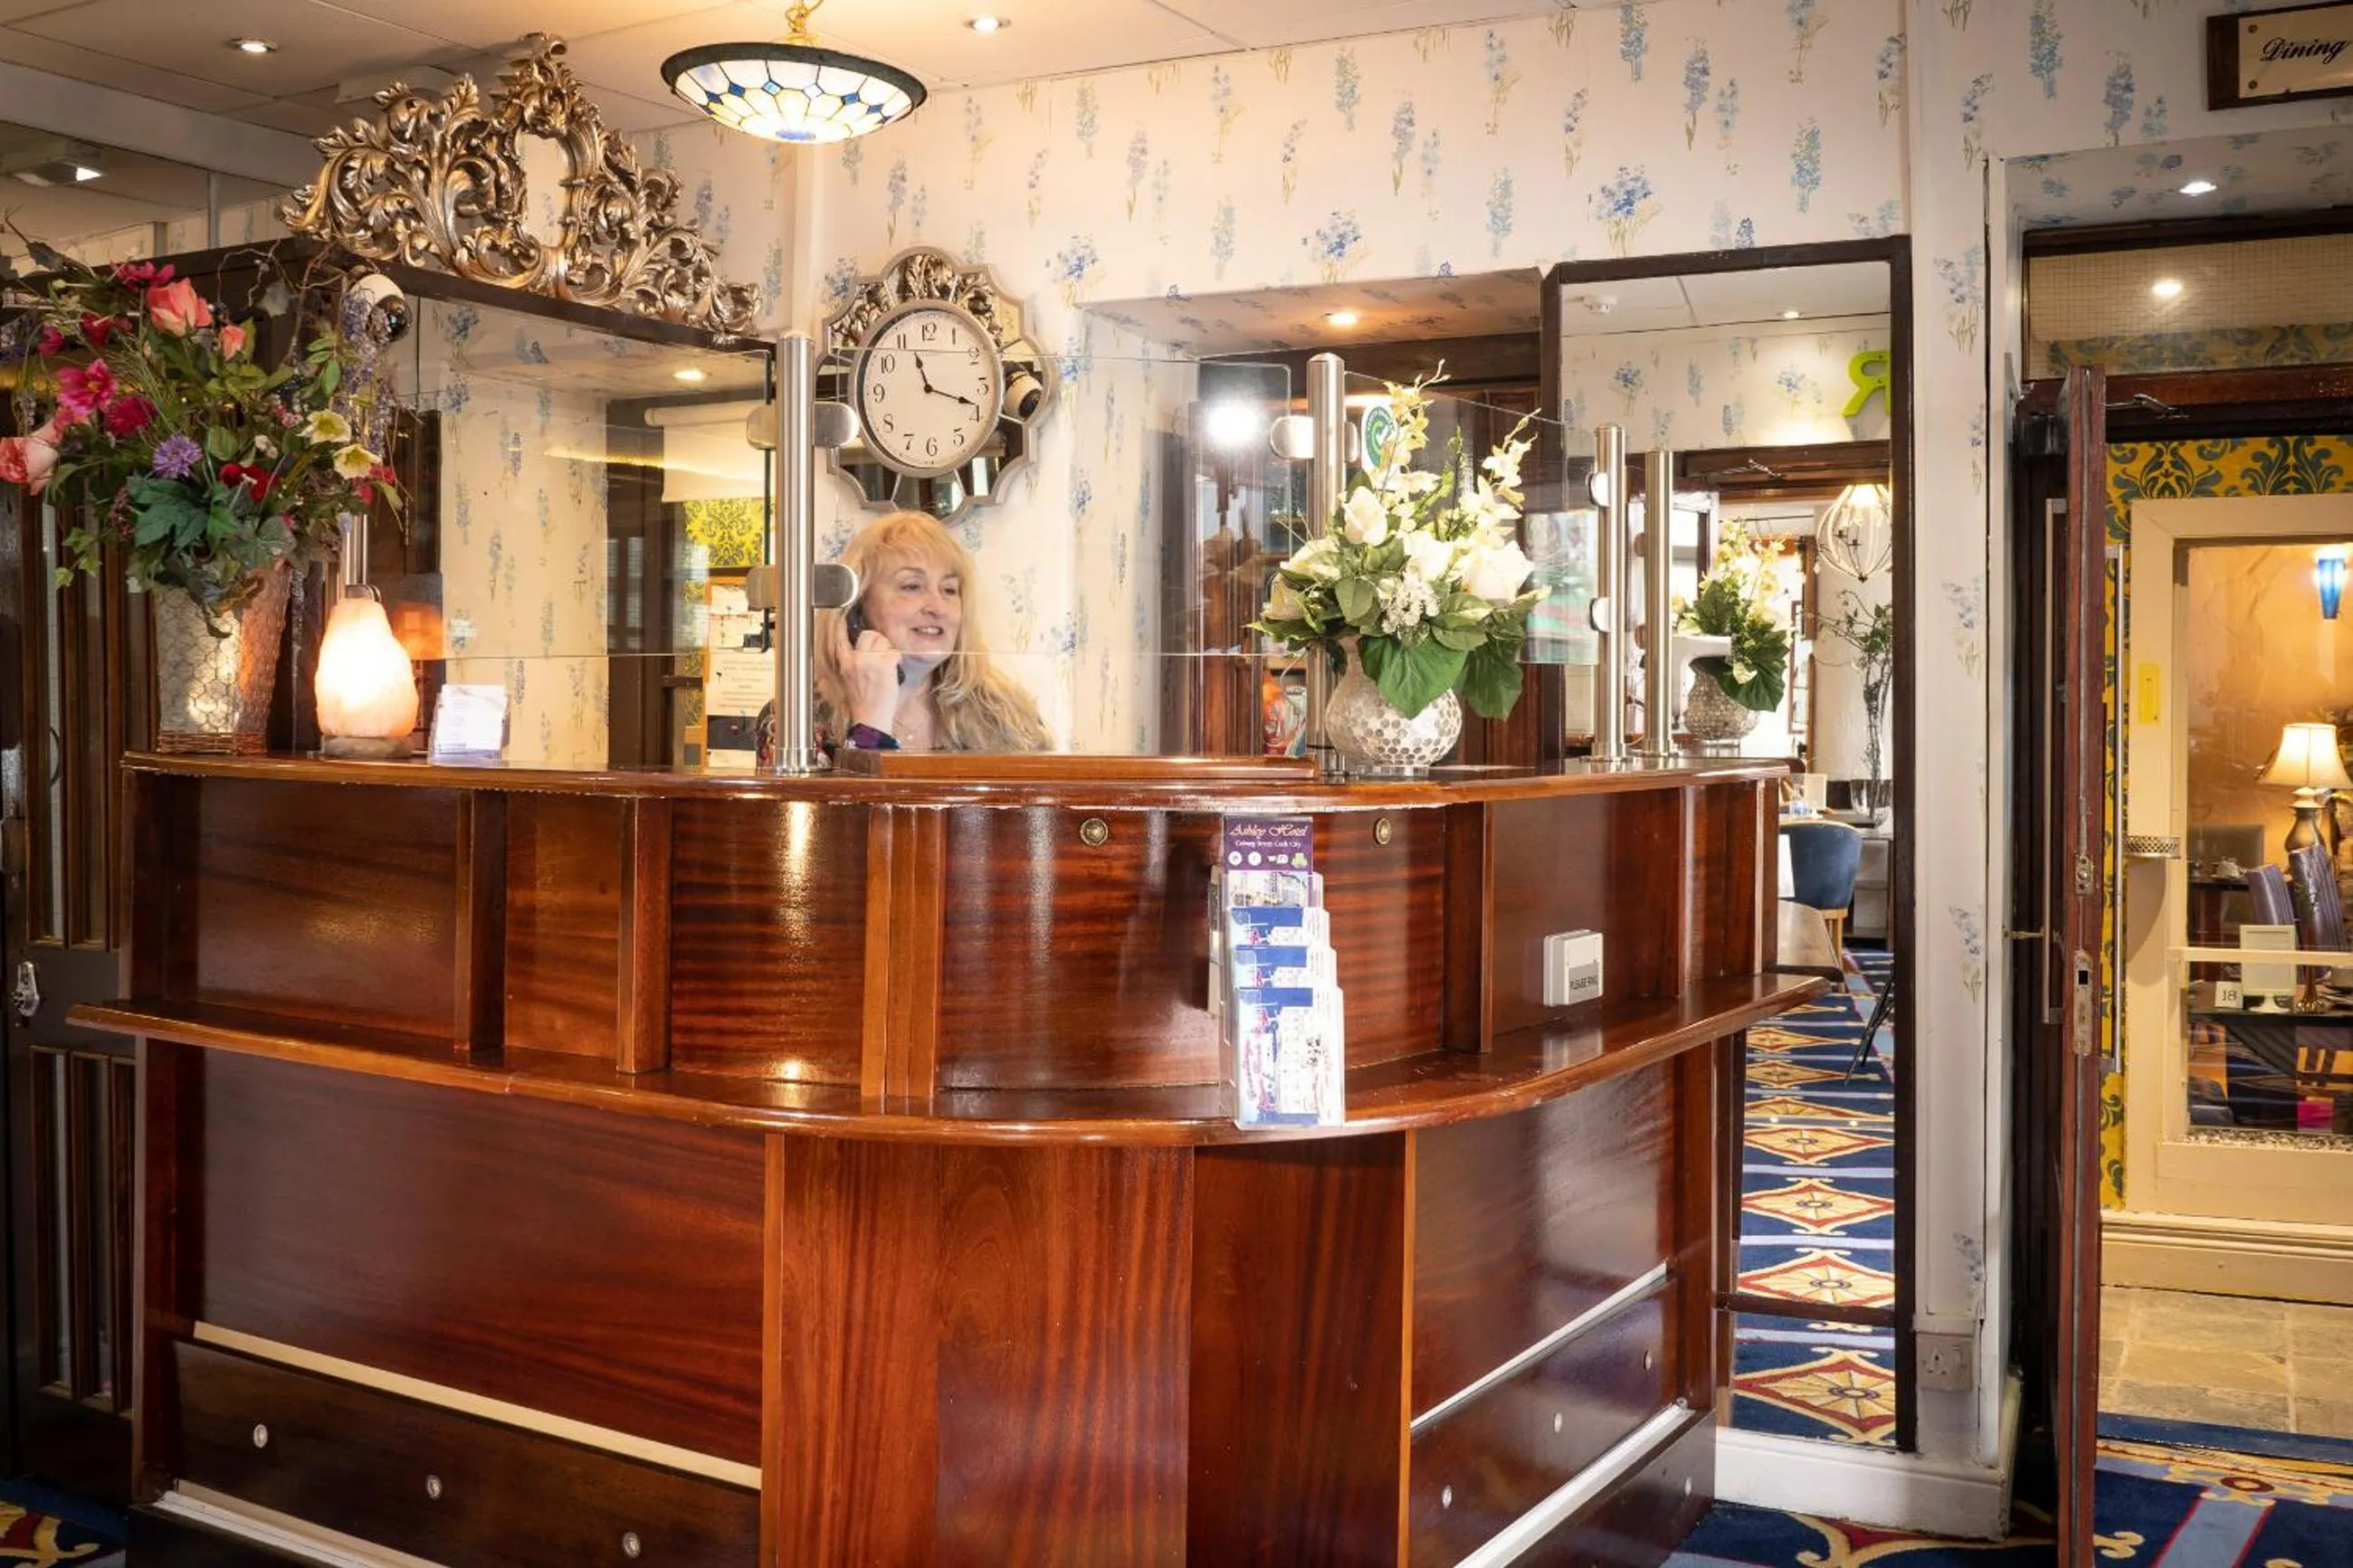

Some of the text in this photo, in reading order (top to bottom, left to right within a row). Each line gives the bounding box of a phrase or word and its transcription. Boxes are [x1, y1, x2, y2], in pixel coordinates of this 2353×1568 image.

[2260, 37, 2349, 65] Dining
[897, 333, 906, 349] 11
[921, 322, 937, 341] 12
[881, 354, 895, 374] 10
[967, 347, 979, 366] 2
[872, 383, 885, 403] 9
[976, 376, 989, 395] 3
[882, 413, 894, 433] 8
[969, 404, 980, 423] 4
[903, 432, 914, 451] 7
[926, 436, 938, 456] 6
[953, 427, 964, 446] 5
[1230, 823, 1309, 839] Ashley Hotel
